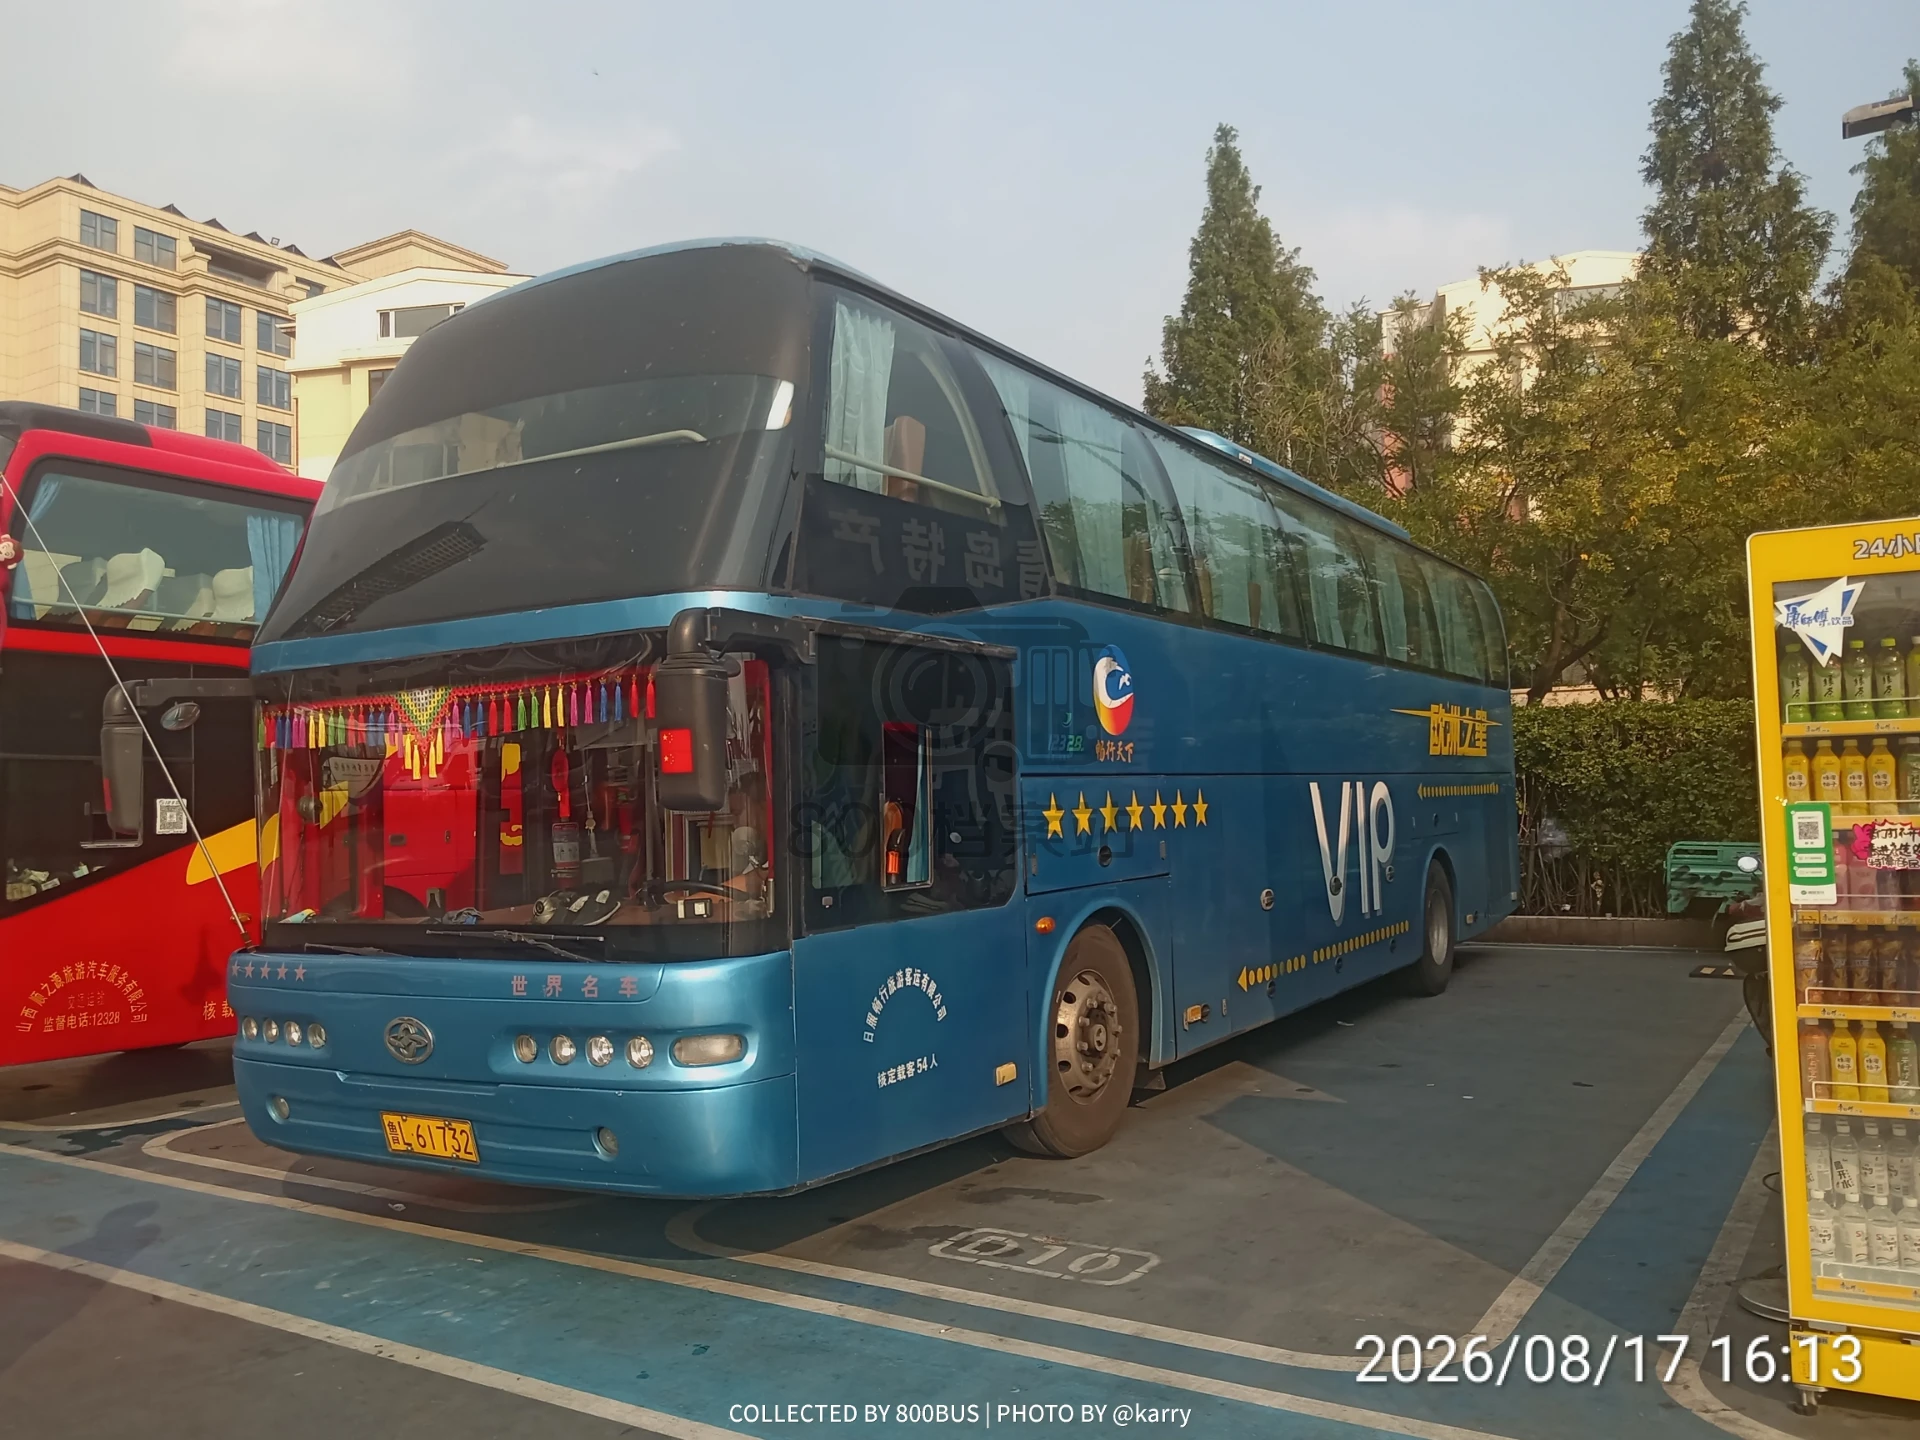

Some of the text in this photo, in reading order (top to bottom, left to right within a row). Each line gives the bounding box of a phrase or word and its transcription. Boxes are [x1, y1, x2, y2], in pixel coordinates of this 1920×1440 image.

[1853, 533, 1920, 560] 24小
[1429, 703, 1488, 757] 欧洲之星
[1095, 740, 1134, 763] 畅行天下
[1309, 781, 1395, 922] VIP
[511, 975, 639, 998] 世界名车
